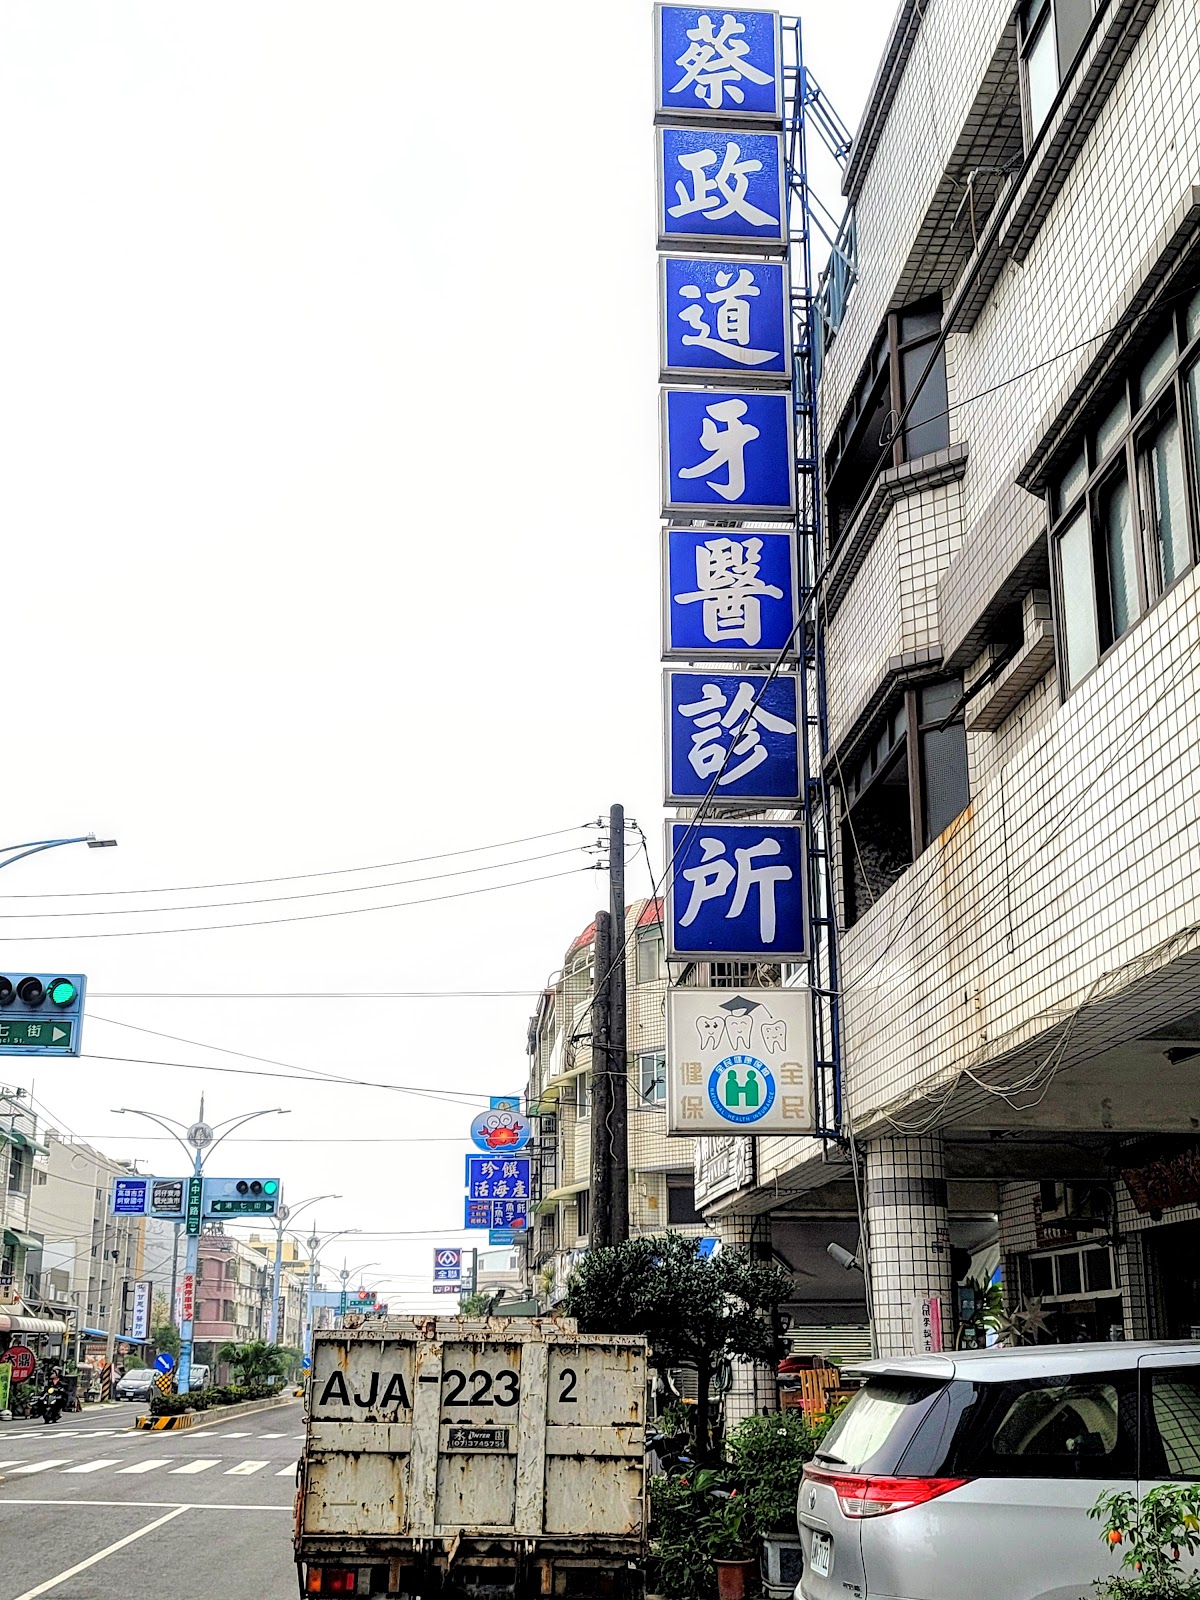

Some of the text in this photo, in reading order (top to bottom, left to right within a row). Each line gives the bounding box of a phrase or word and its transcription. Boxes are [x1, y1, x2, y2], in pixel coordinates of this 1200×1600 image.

[667, 14, 797, 944] 蔡政道牙醫診所
[709, 1087, 775, 1122] NATIONAL HEALTH INSURANCE
[481, 1161, 520, 1179] 珍饌
[189, 1185, 200, 1215] 中正路
[474, 1180, 528, 1198] 活海產
[505, 1200, 514, 1222] 魚子
